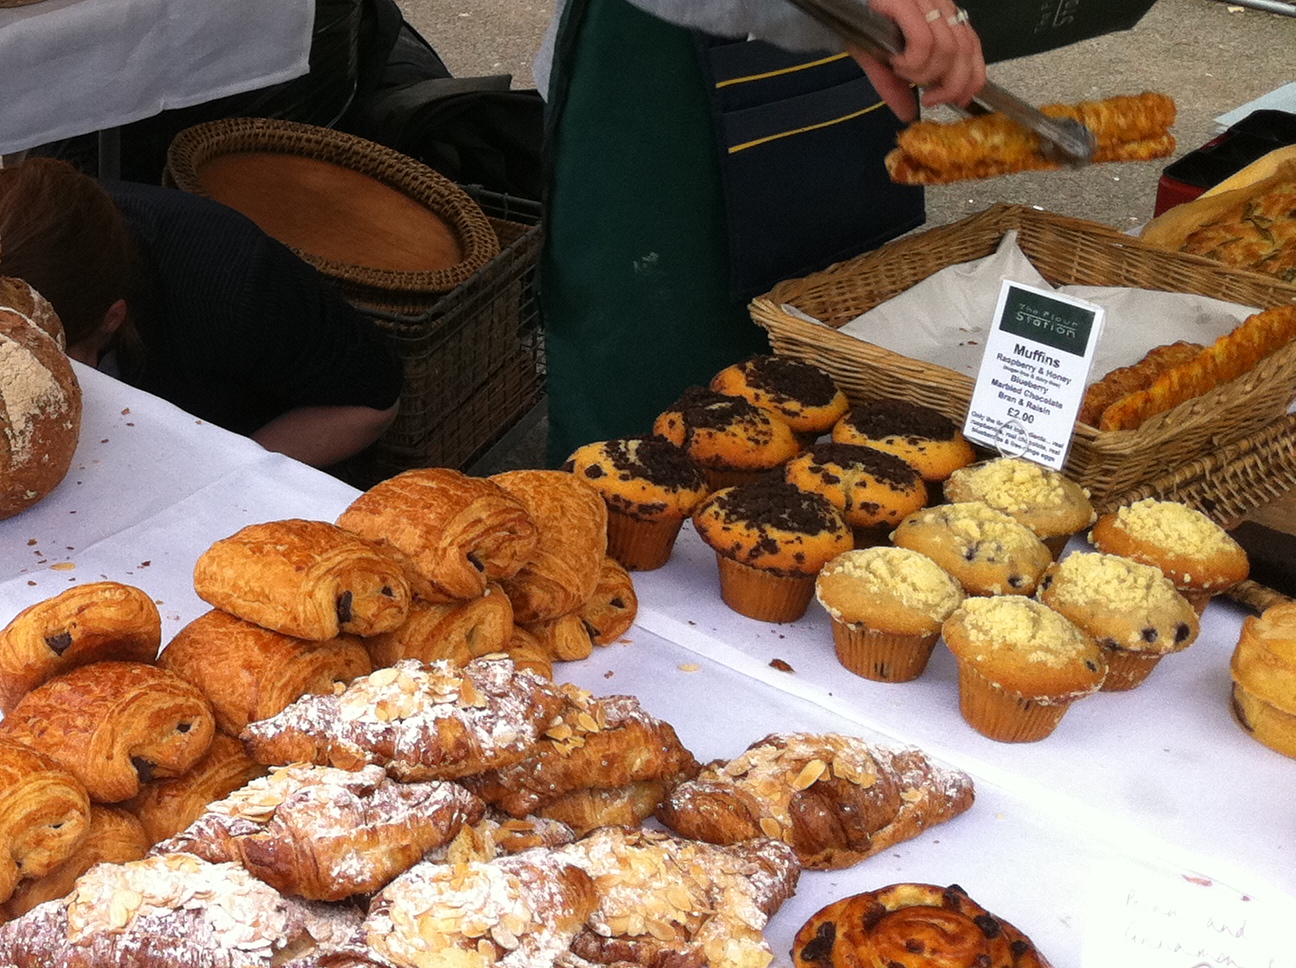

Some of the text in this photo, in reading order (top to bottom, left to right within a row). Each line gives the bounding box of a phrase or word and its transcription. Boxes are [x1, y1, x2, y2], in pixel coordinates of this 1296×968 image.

[1015, 310, 1077, 338] Station
[1018, 303, 1078, 327] The Flour
[1013, 343, 1061, 368] Muffins
[995, 352, 1071, 385] Raspberry & Honey
[990, 378, 1063, 409] Marbled Chocolate
[1009, 375, 1048, 394] Blueberry
[997, 391, 1051, 415] Bran & Raisin
[970, 410, 985, 421] Only
[1006, 407, 1034, 424] £2.00
[1207, 917, 1248, 940] and
